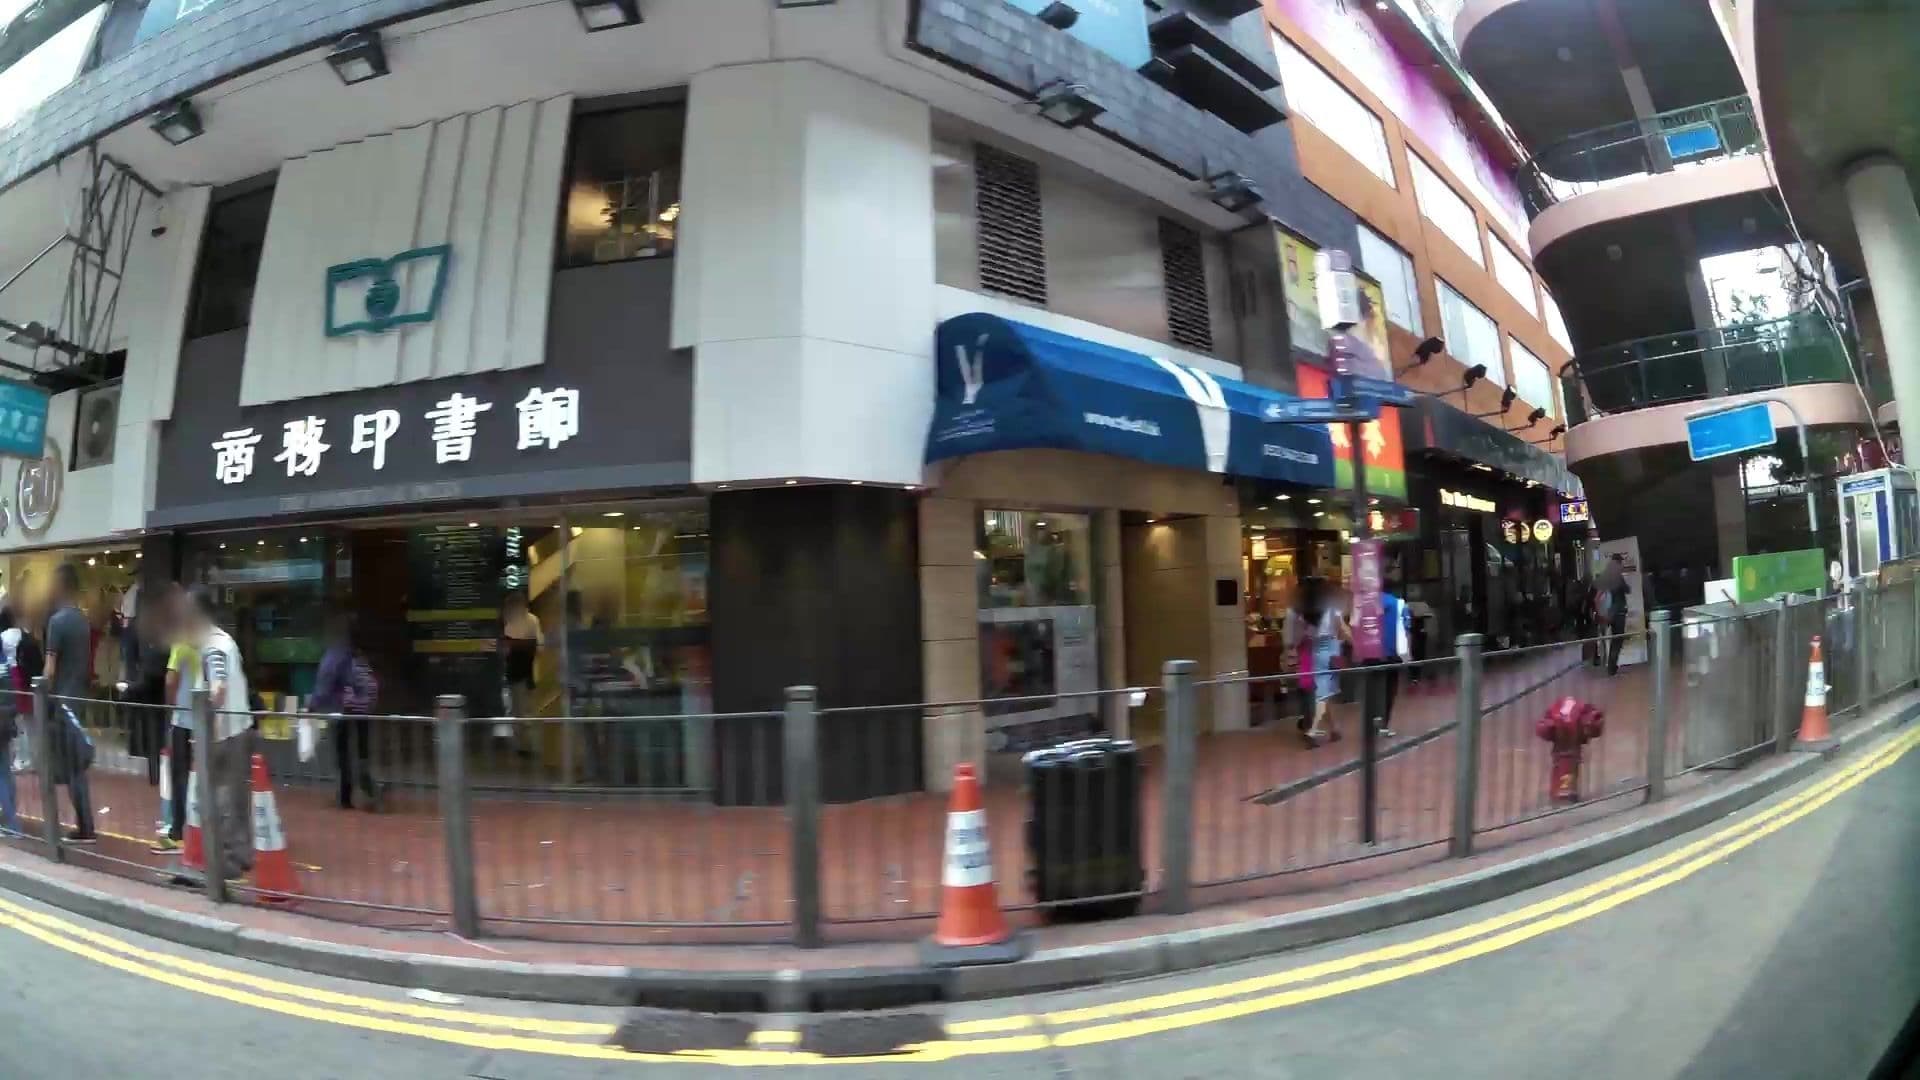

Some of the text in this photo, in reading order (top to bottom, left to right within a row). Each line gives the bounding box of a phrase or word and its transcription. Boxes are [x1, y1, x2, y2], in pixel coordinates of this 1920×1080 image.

[211, 387, 580, 484] 商務印書館
